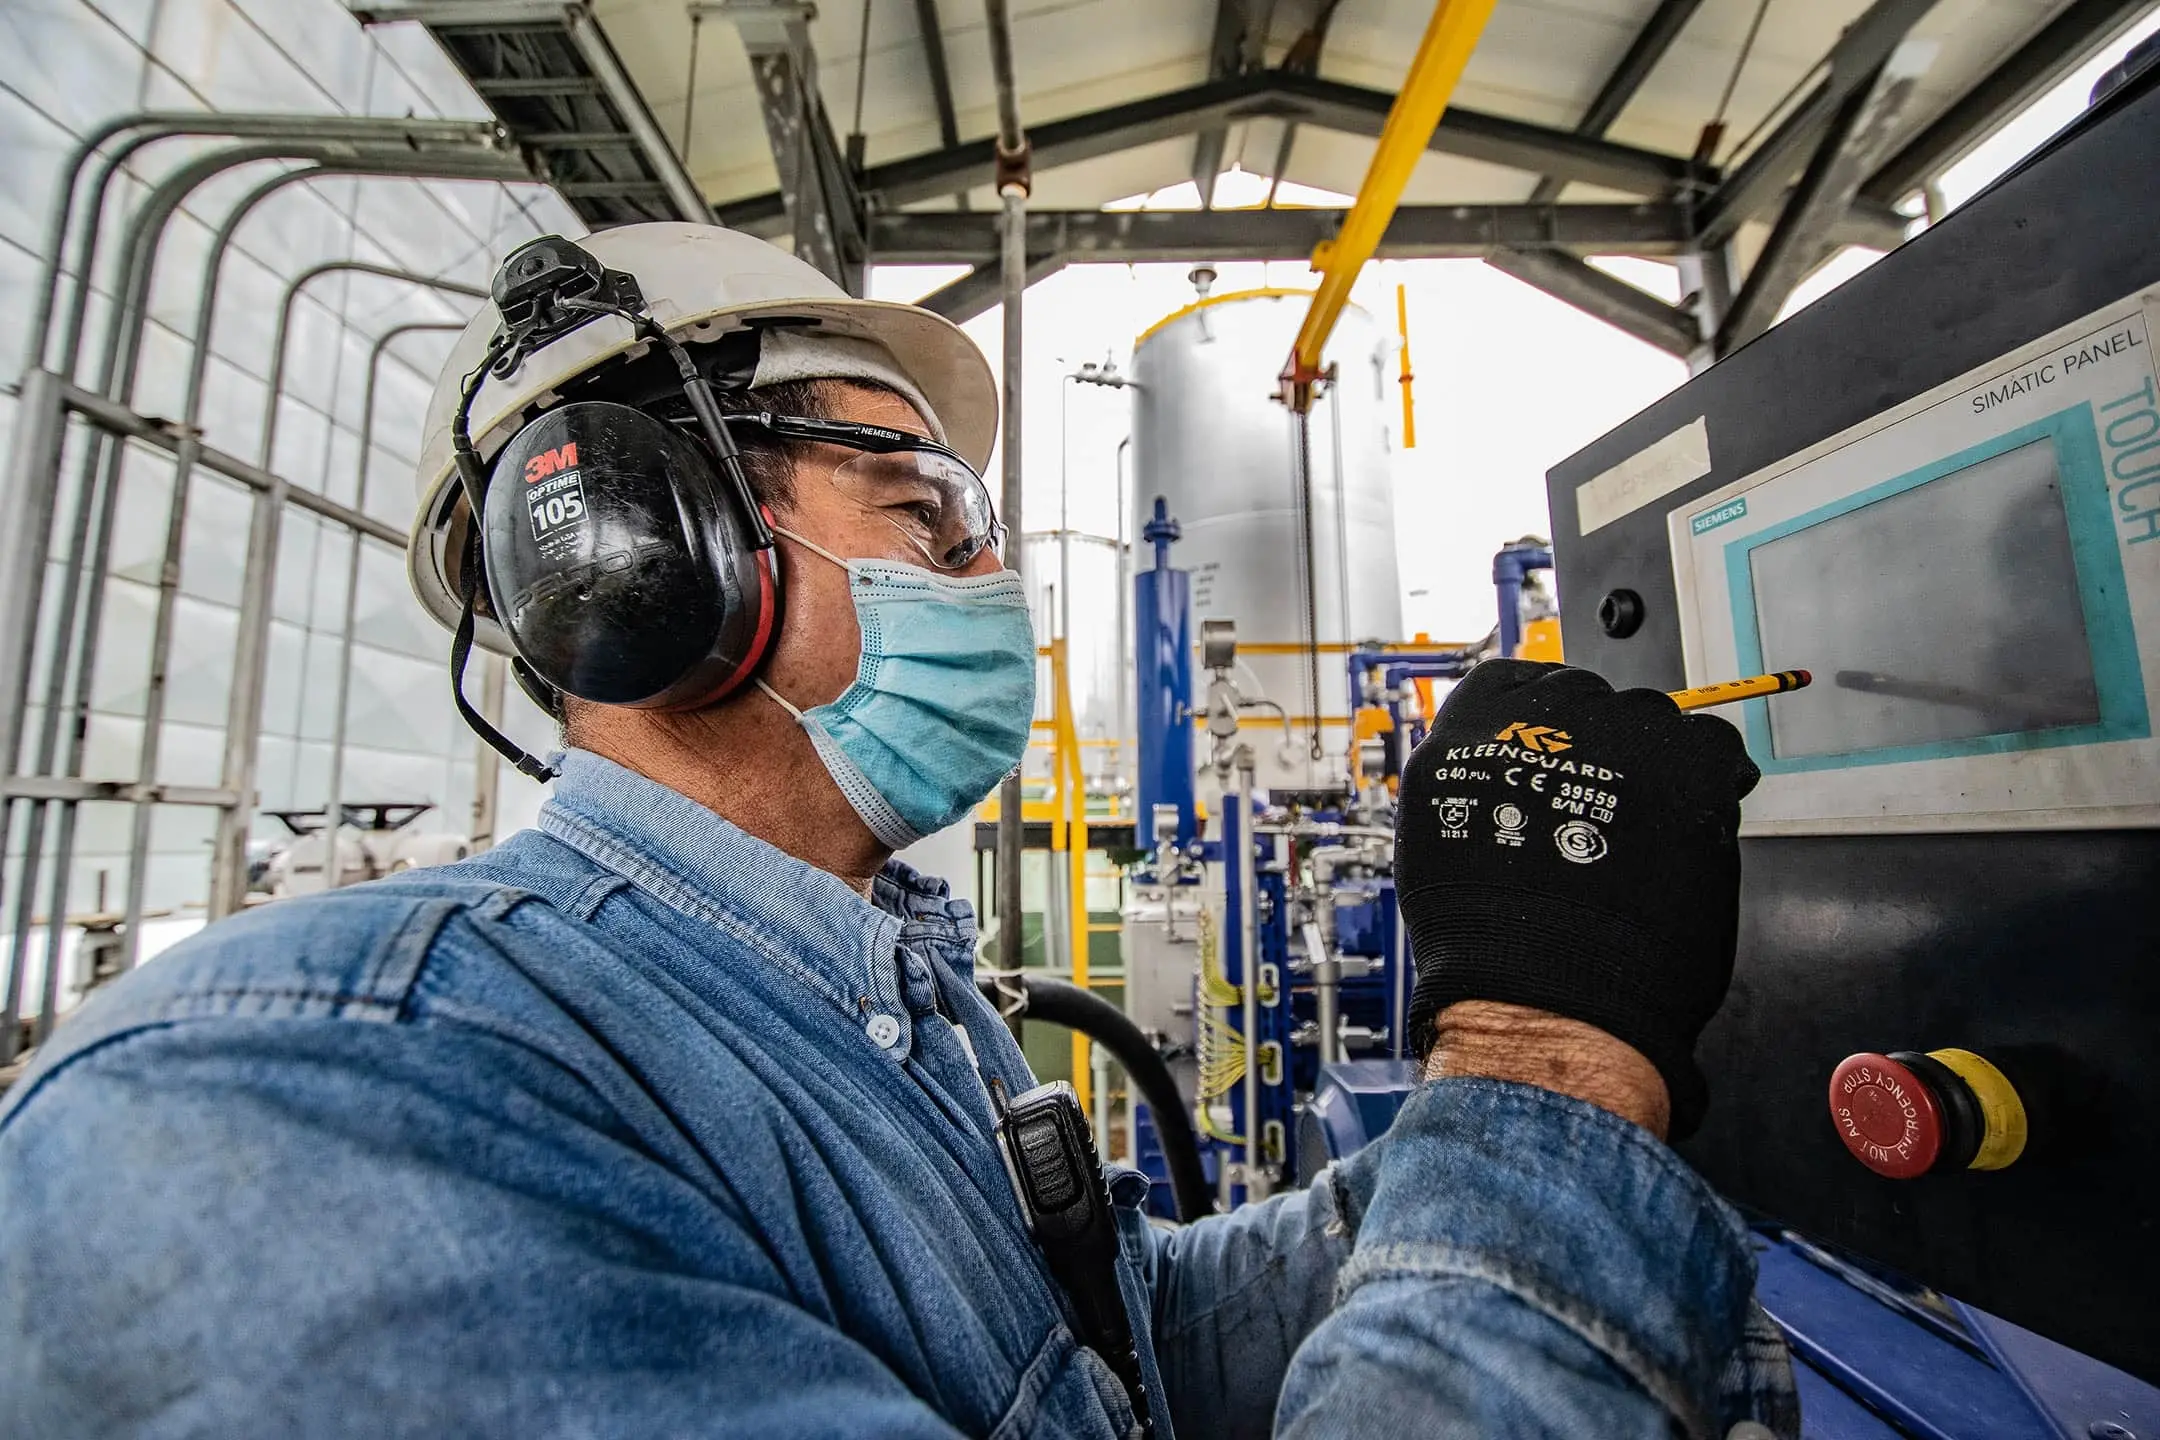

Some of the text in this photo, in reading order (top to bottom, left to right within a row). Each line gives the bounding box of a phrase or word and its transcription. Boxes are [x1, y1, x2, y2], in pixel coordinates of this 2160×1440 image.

[1972, 329, 2143, 414] SIMATIC PANEL
[860, 426, 901, 441] NEMESIS
[525, 442, 578, 484] 3M
[2100, 376, 2160, 545] TOUCH
[529, 473, 578, 501] OPTIME
[532, 490, 584, 531] 105
[1694, 502, 1745, 532] SIEMENS
[1551, 796, 1585, 815] 8/M
[1560, 782, 1618, 809] 39559
[1844, 1067, 1871, 1094] STOP
[1839, 1107, 1861, 1137] AUS
